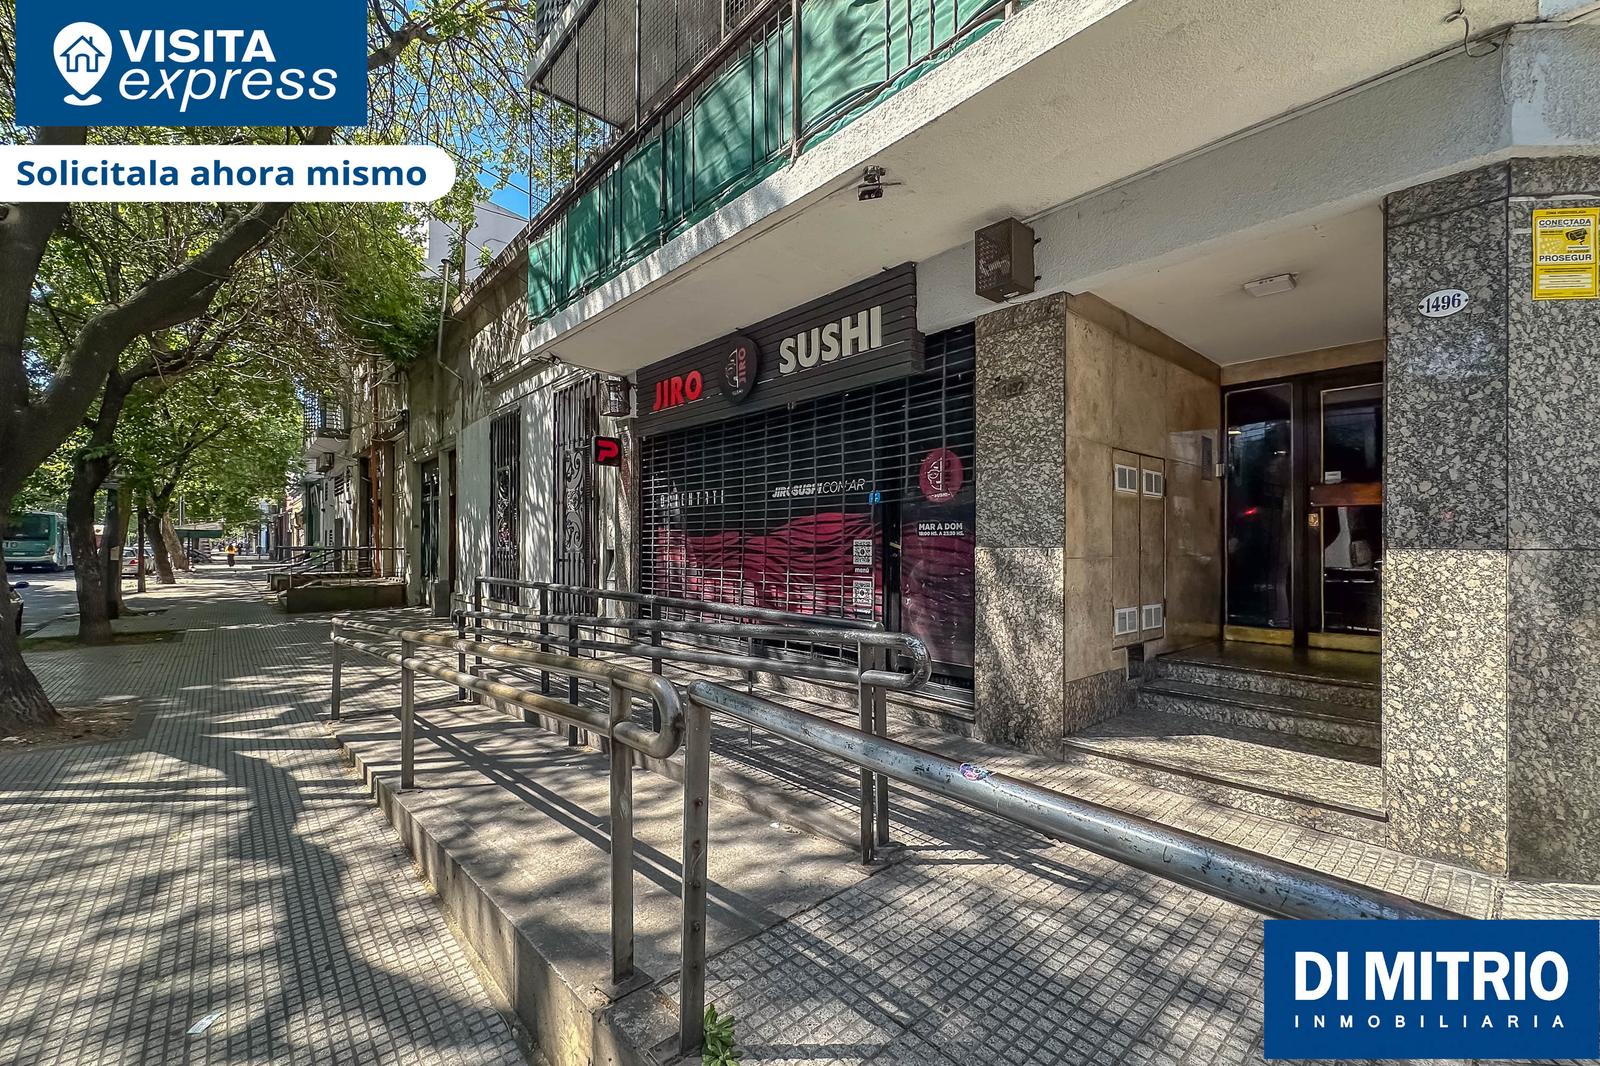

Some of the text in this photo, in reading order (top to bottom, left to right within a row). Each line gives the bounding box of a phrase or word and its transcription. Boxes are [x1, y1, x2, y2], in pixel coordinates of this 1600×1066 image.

[1539, 254, 1592, 262] PROSEGUR
[1426, 293, 1461, 313] 1496
[779, 305, 882, 374] SUSHI
[738, 347, 746, 384] JIRO
[652, 370, 703, 411] JIRO
[918, 522, 963, 531] MAR A DOM
